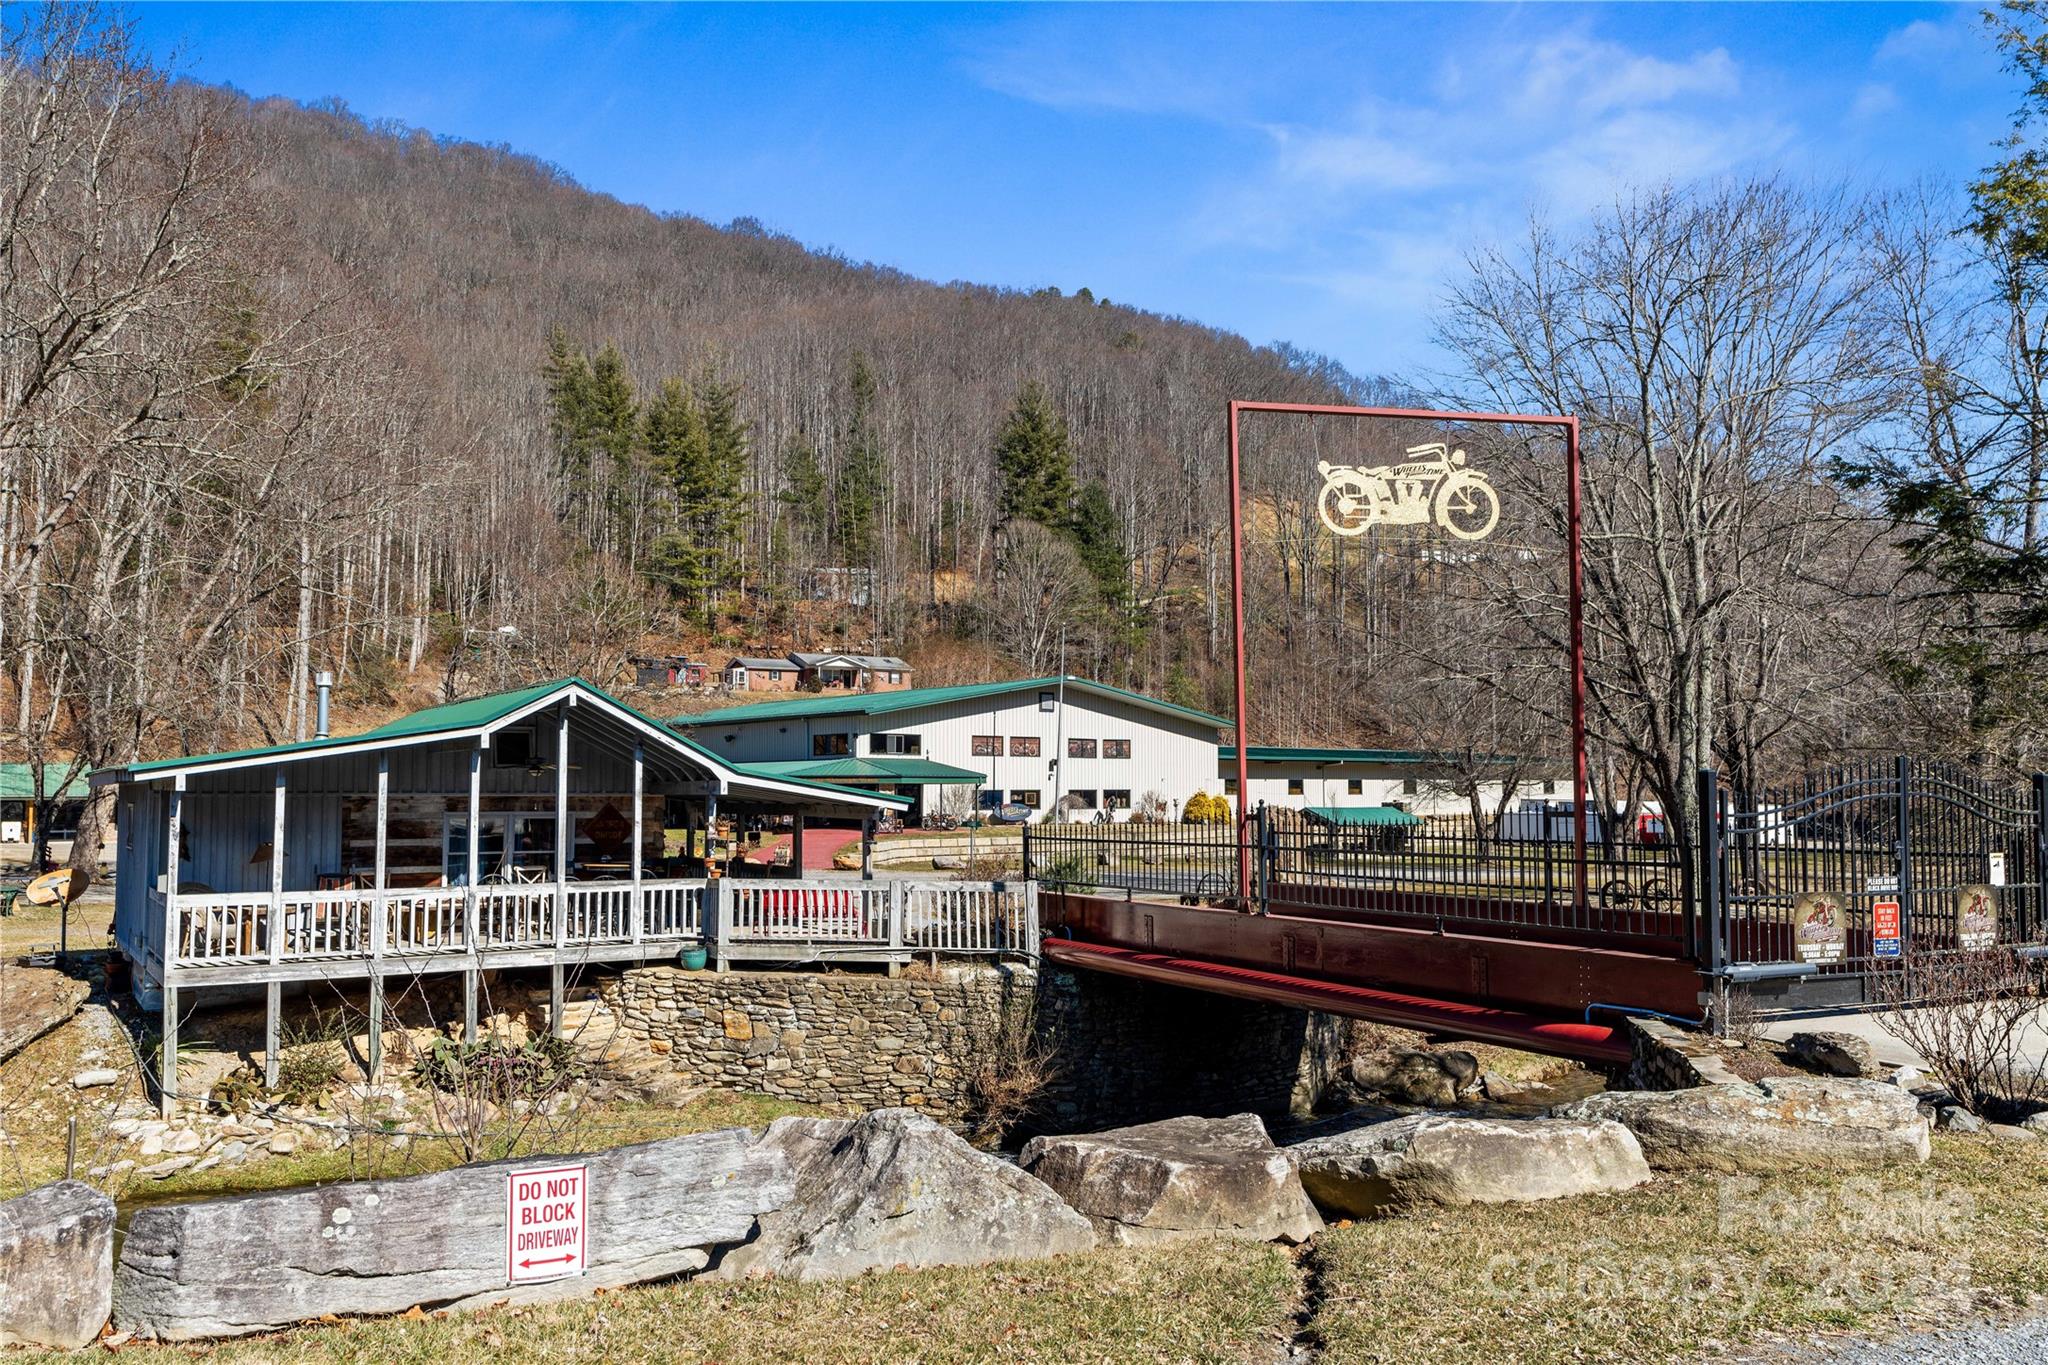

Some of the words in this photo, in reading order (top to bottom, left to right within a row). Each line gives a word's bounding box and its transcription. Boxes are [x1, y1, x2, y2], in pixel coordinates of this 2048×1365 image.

[519, 1181, 542, 1201] DO
[547, 1177, 578, 1198] NOT
[521, 1202, 576, 1225] BLOCK
[517, 1226, 579, 1251] DRIVEWAY
